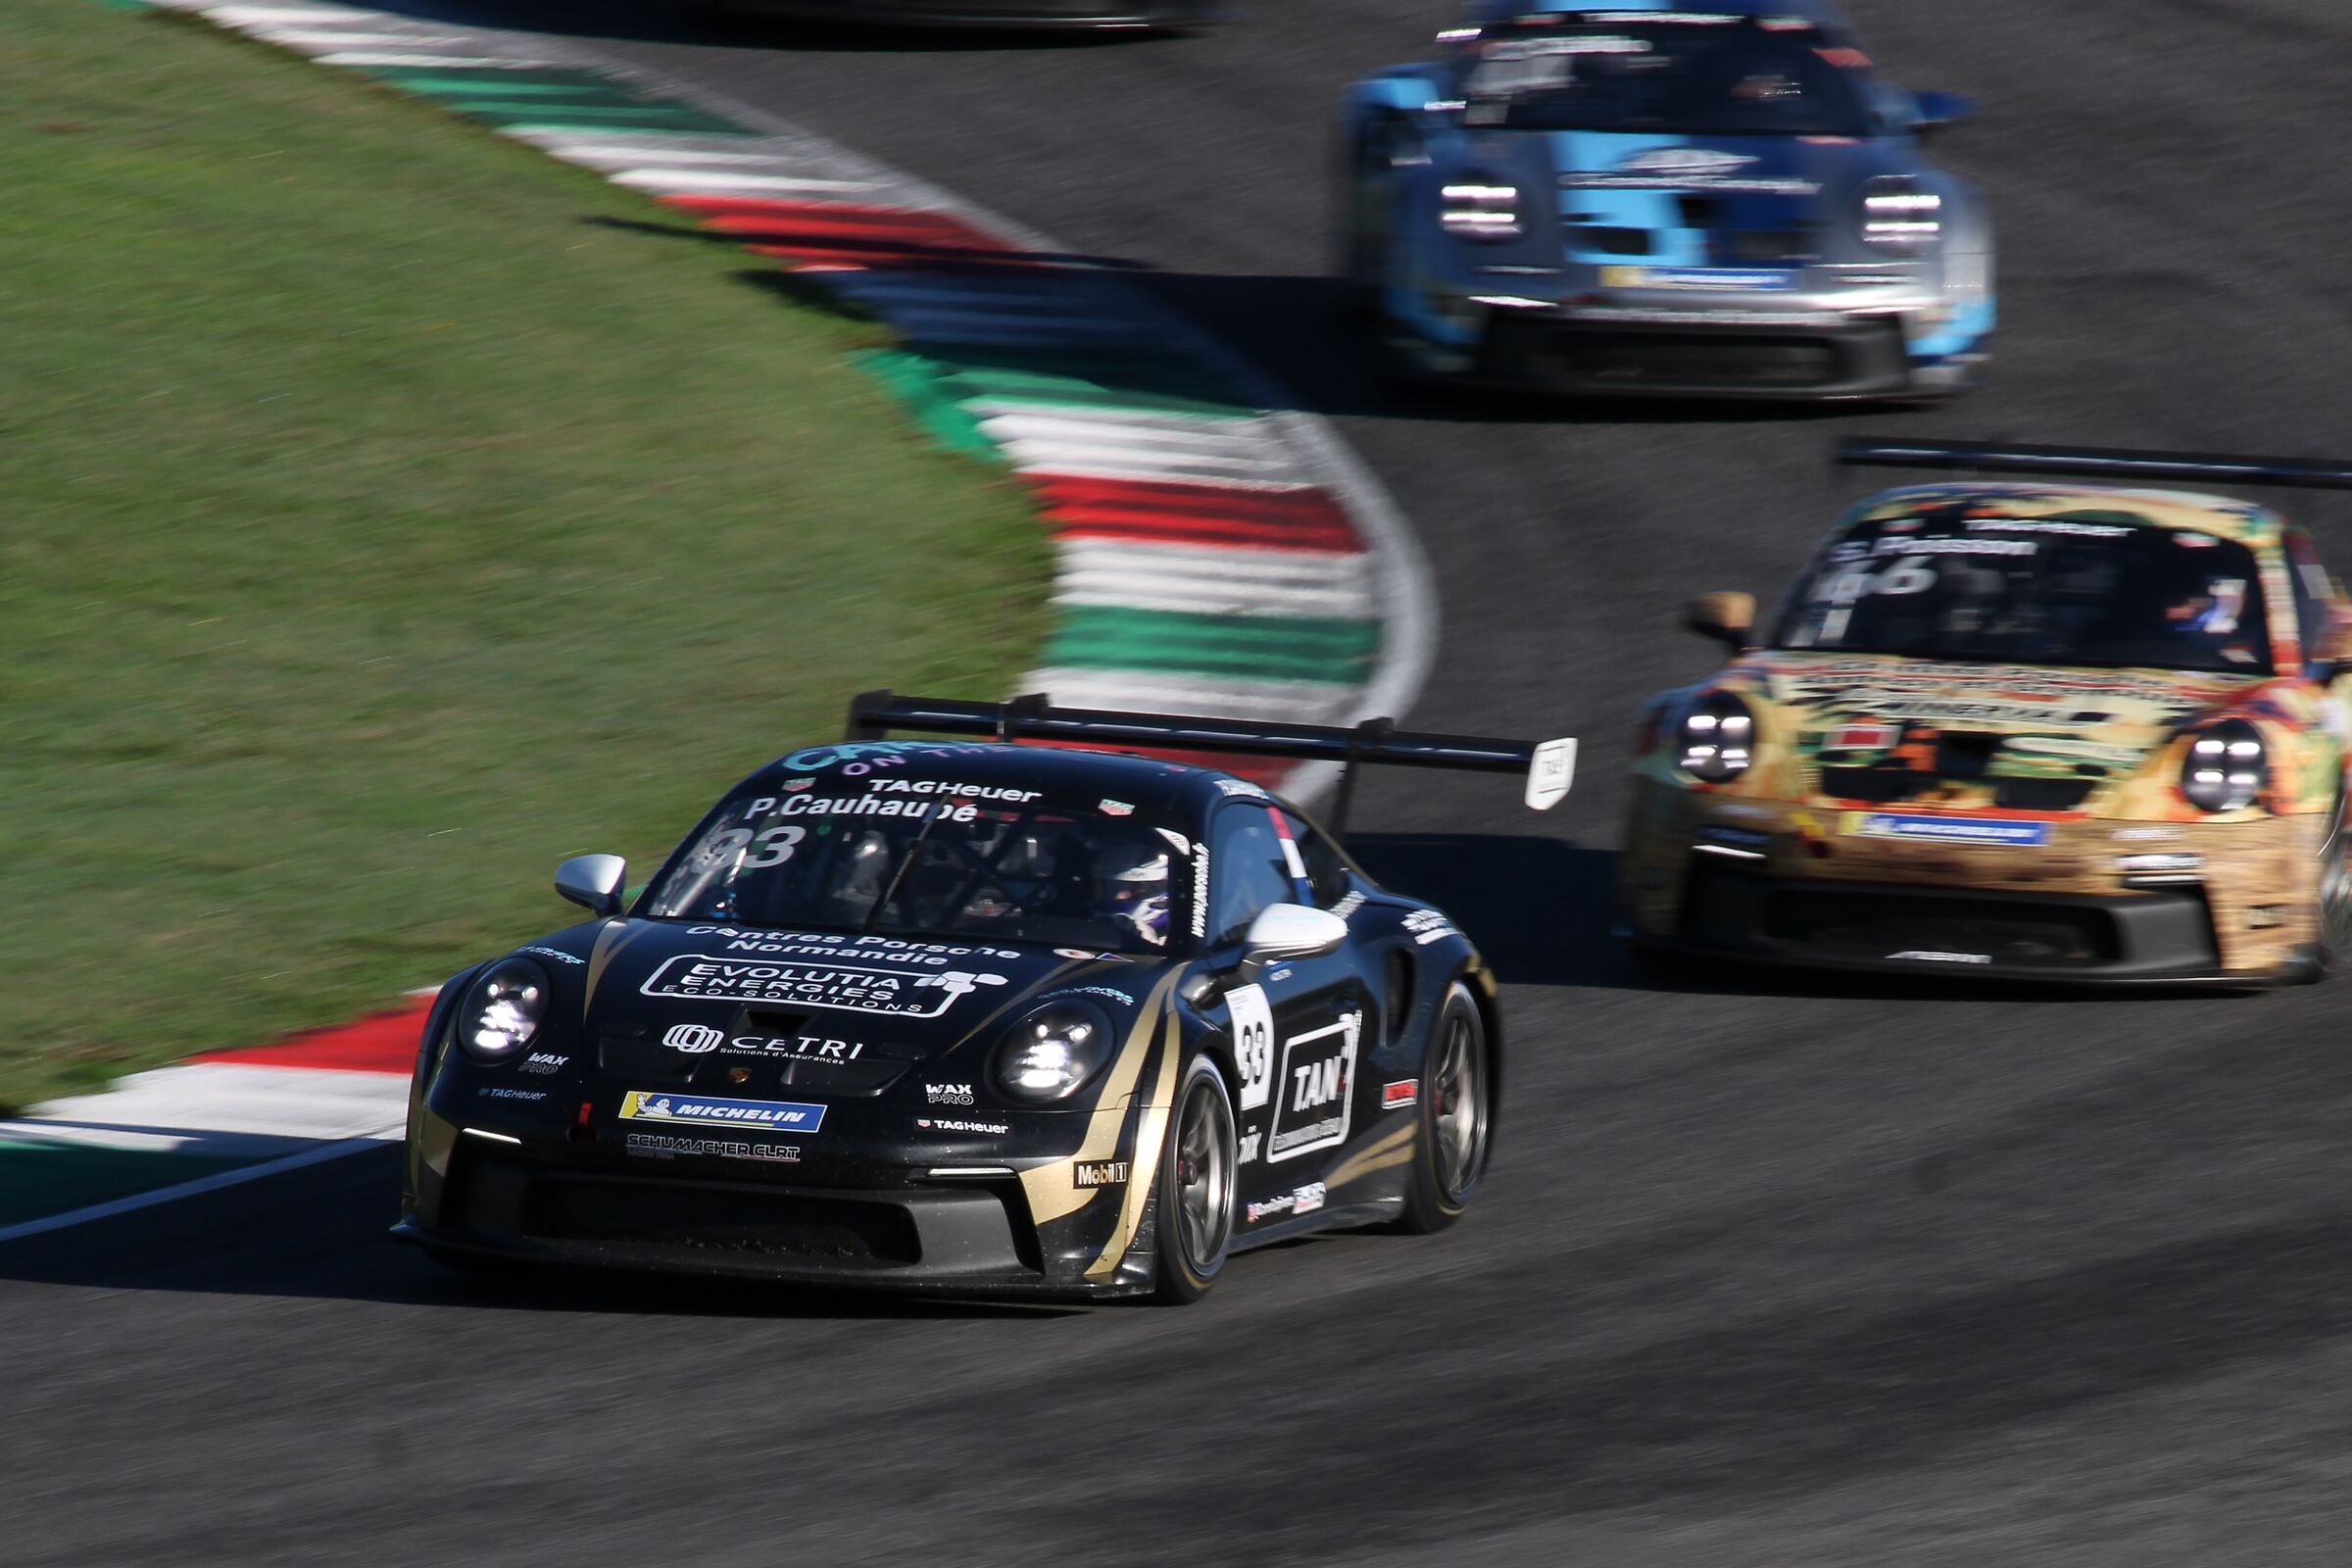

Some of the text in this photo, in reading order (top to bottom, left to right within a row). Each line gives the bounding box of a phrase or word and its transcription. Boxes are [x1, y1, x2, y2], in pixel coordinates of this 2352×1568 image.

[842, 755, 907, 776] ON
[726, 940, 949, 965] Normandie
[690, 963, 901, 990] EVOLUTIA
[662, 984, 923, 1012] ECO-SOLUTIONS
[680, 974, 895, 1001] ENERGIES
[719, 1047, 845, 1065] Solutions d'Assurances
[731, 1036, 864, 1060] CETRI
[1239, 1021, 1265, 1089] 33
[518, 1062, 559, 1075] PRO
[527, 1053, 569, 1066] WAX
[925, 1084, 973, 1095] WAX
[928, 1094, 974, 1105] PRO
[676, 1104, 807, 1123] MICHELIN
[626, 1133, 751, 1157] SCHUMACHER
[1078, 1164, 1114, 1185] Mobil
